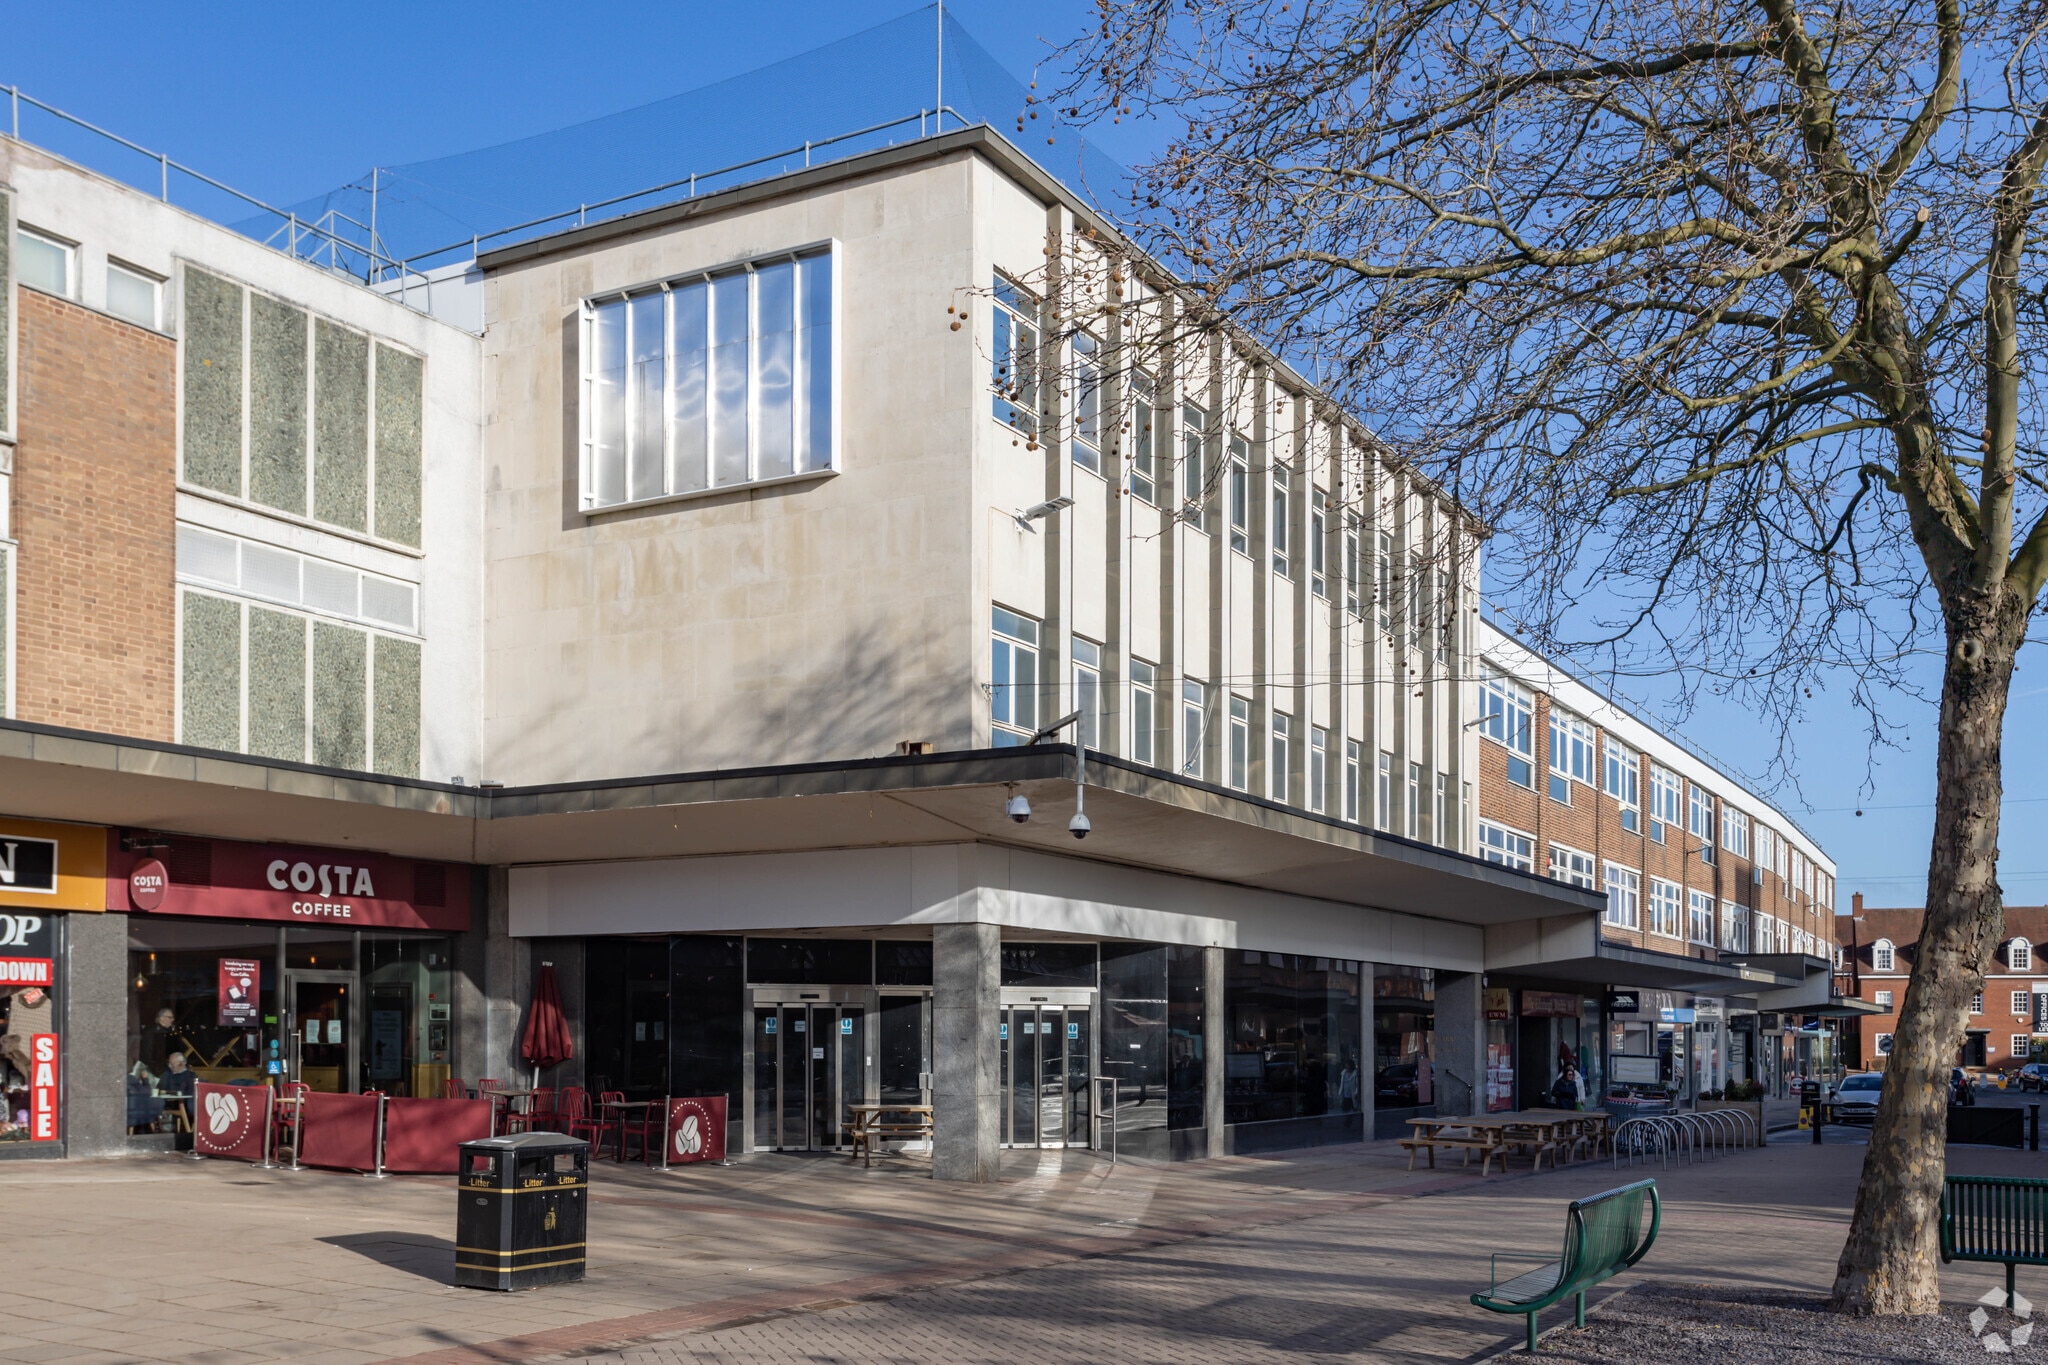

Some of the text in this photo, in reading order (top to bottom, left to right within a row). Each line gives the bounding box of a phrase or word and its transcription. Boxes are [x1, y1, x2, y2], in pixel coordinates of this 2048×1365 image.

[133, 875, 162, 888] COSTA
[266, 859, 375, 898] COSTA
[292, 901, 351, 918] COFFEE
[0, 961, 47, 982] DOWN
[35, 1037, 54, 1138] SALE
[471, 1178, 489, 1187] Litter
[525, 1179, 543, 1187] Litter
[559, 1176, 577, 1185] Litter
